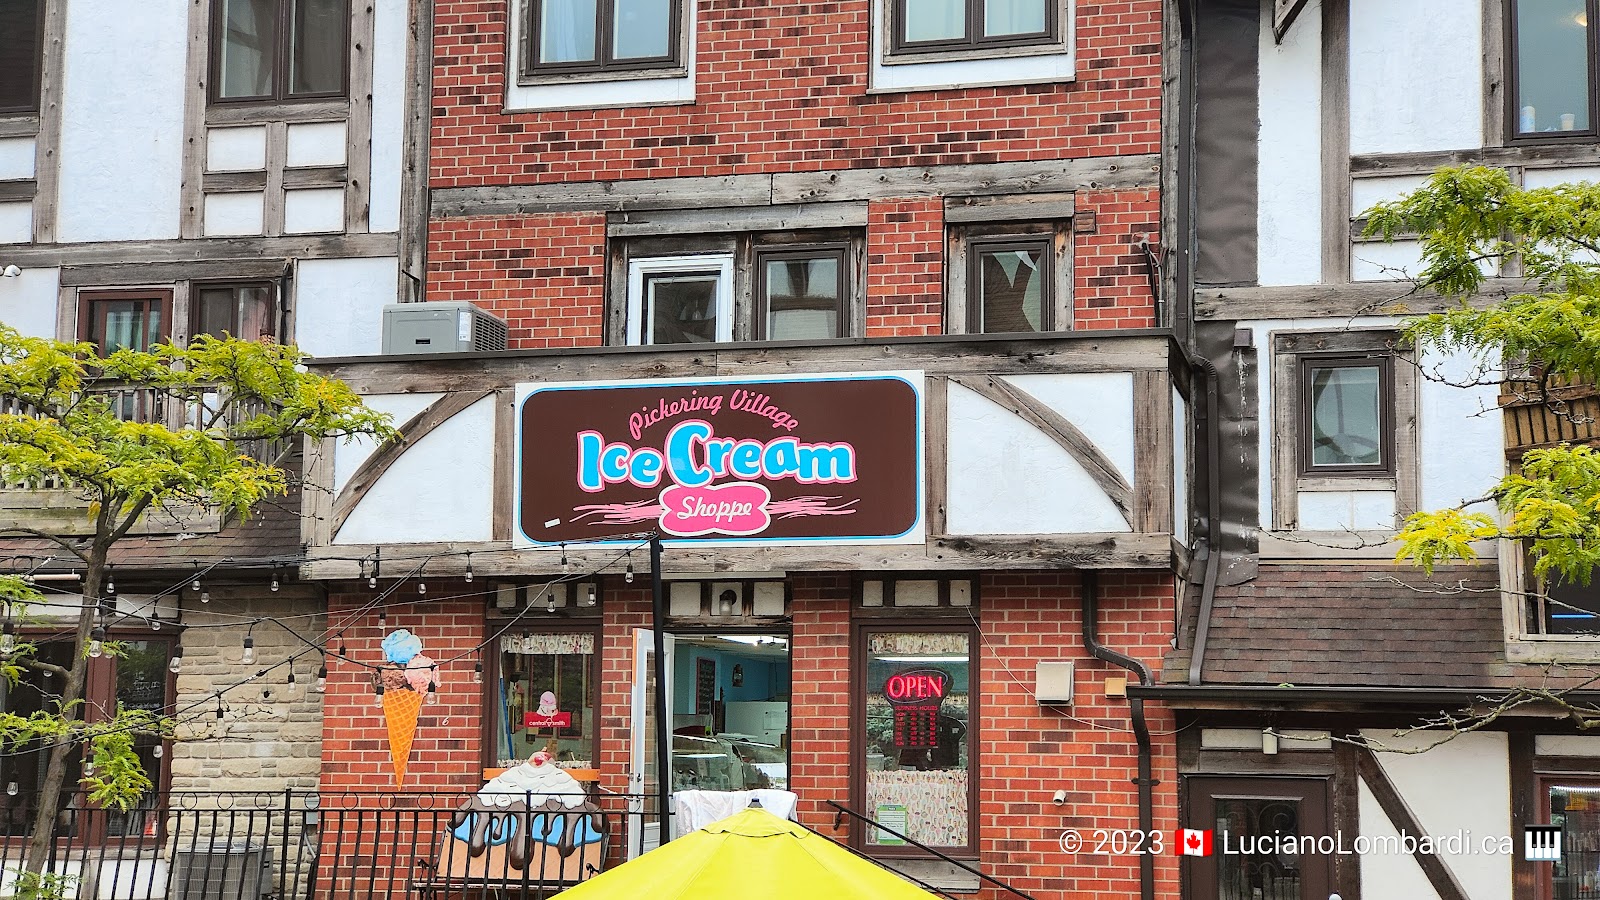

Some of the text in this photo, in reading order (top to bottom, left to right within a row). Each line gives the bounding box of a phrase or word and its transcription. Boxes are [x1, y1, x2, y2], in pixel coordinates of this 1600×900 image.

[629, 388, 798, 440] Pickering Village
[577, 418, 858, 493] Ice Cream
[676, 495, 754, 522] Shoppe
[887, 675, 943, 699] OPEN
